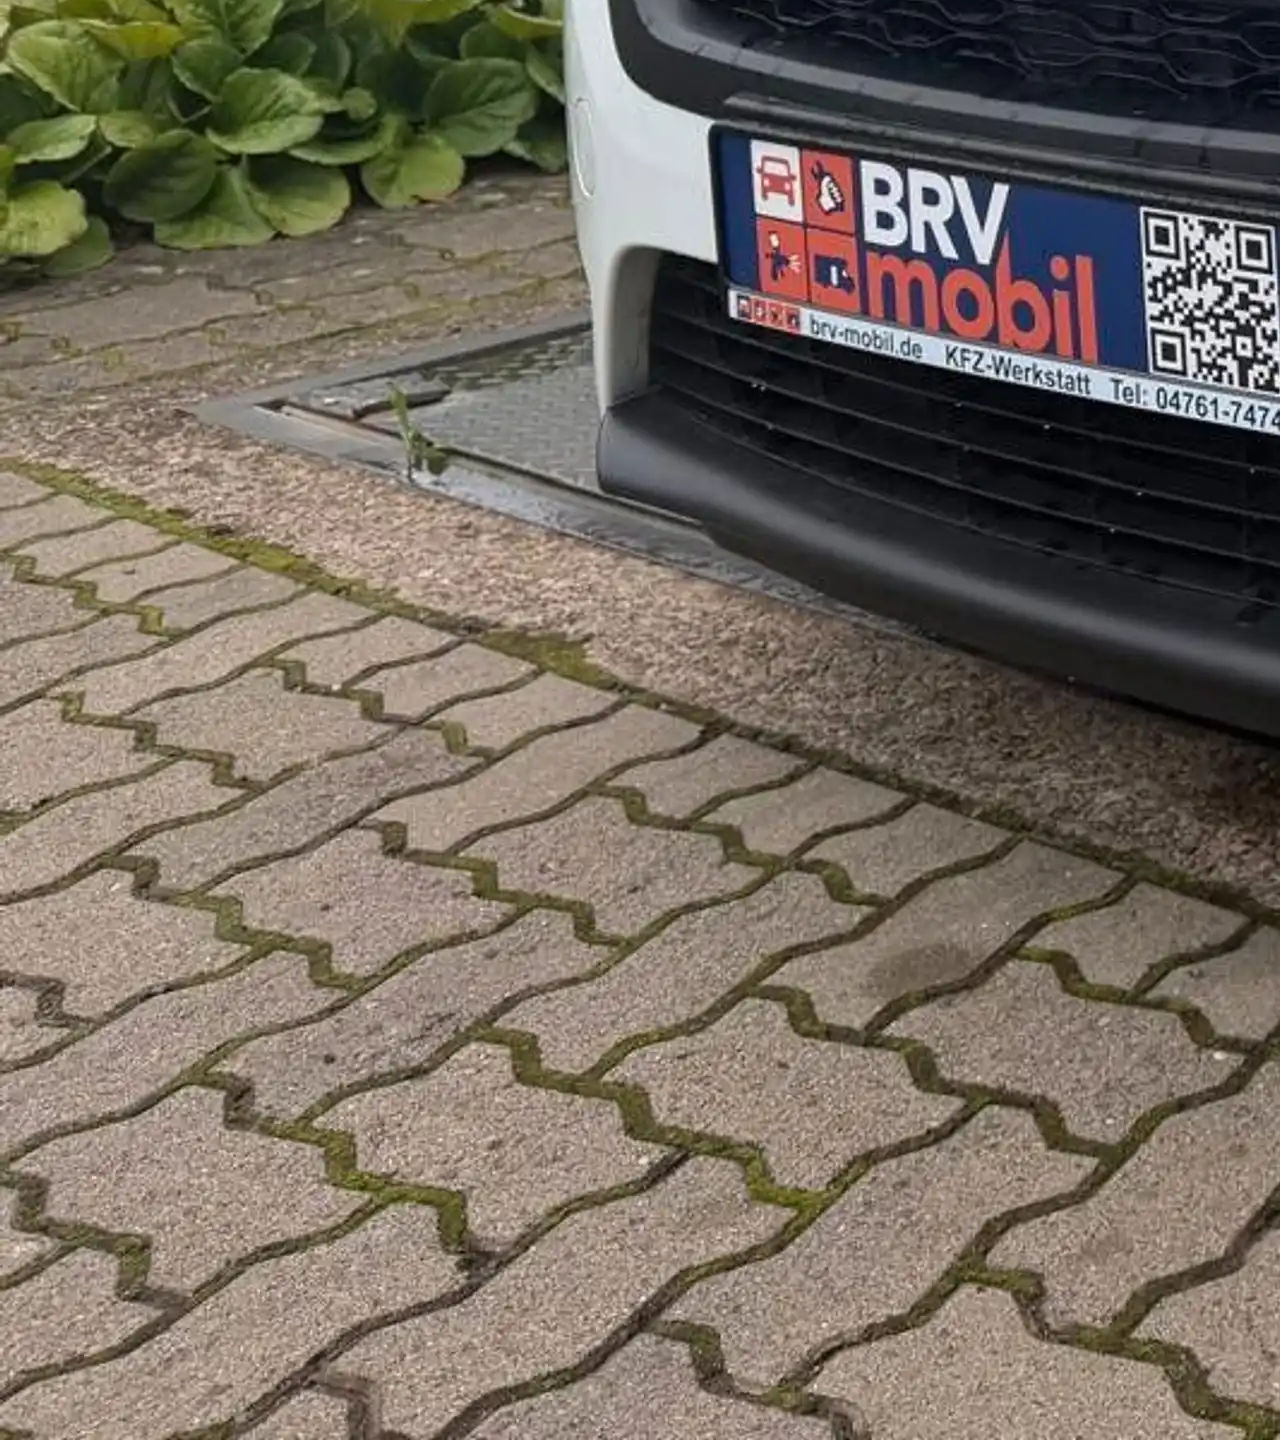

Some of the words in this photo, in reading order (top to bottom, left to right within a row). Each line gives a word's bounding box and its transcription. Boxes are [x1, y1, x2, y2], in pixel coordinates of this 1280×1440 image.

[860, 160, 1009, 264] BRV
[865, 230, 1098, 364] mobil
[809, 314, 922, 359] brv-mobil.de
[944, 344, 1091, 395] KFZ-Werkstatt
[1110, 378, 1148, 406] Tel:
